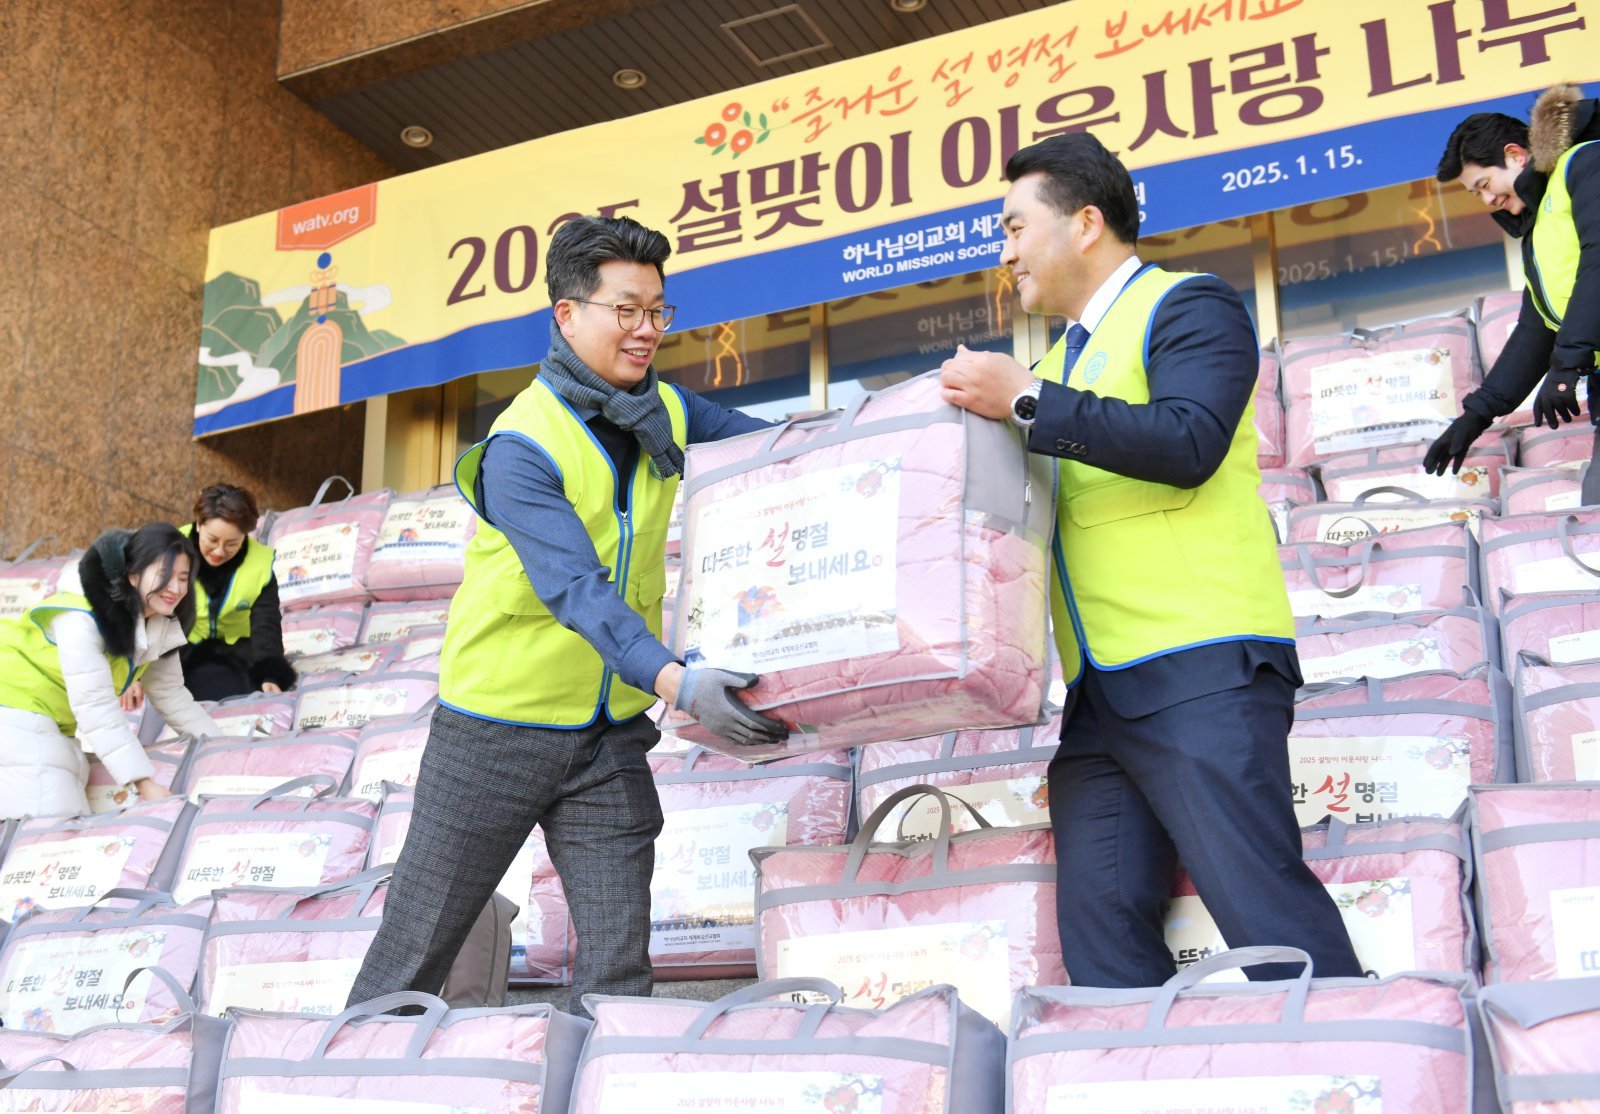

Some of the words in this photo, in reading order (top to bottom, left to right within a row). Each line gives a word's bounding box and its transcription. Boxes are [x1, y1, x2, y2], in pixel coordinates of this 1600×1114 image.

[931, 51, 974, 108] 설
[987, 25, 1079, 88] 명절
[1221, 161, 1289, 193] 2025.
[1295, 154, 1318, 176] 1.
[1323, 144, 1364, 170] 15.
[669, 131, 913, 255] 설맞이
[292, 204, 360, 236] watv.org
[842, 220, 966, 266] 하나님의교회
[842, 263, 895, 284] WORLD
[896, 251, 955, 273] MISSION
[702, 540, 753, 574] 따뜻한
[755, 521, 790, 568] 설
[791, 520, 829, 552] 명절
[787, 548, 871, 586] 보내세요
[1299, 756, 1316, 764] 2025
[1312, 772, 1352, 813] 설
[1354, 781, 1398, 804] 명절
[250, 865, 277, 882] 명절
[669, 840, 697, 876] 설
[698, 844, 731, 867] 명절
[73, 968, 104, 988] 명절
[677, 1097, 696, 1108] 2025
